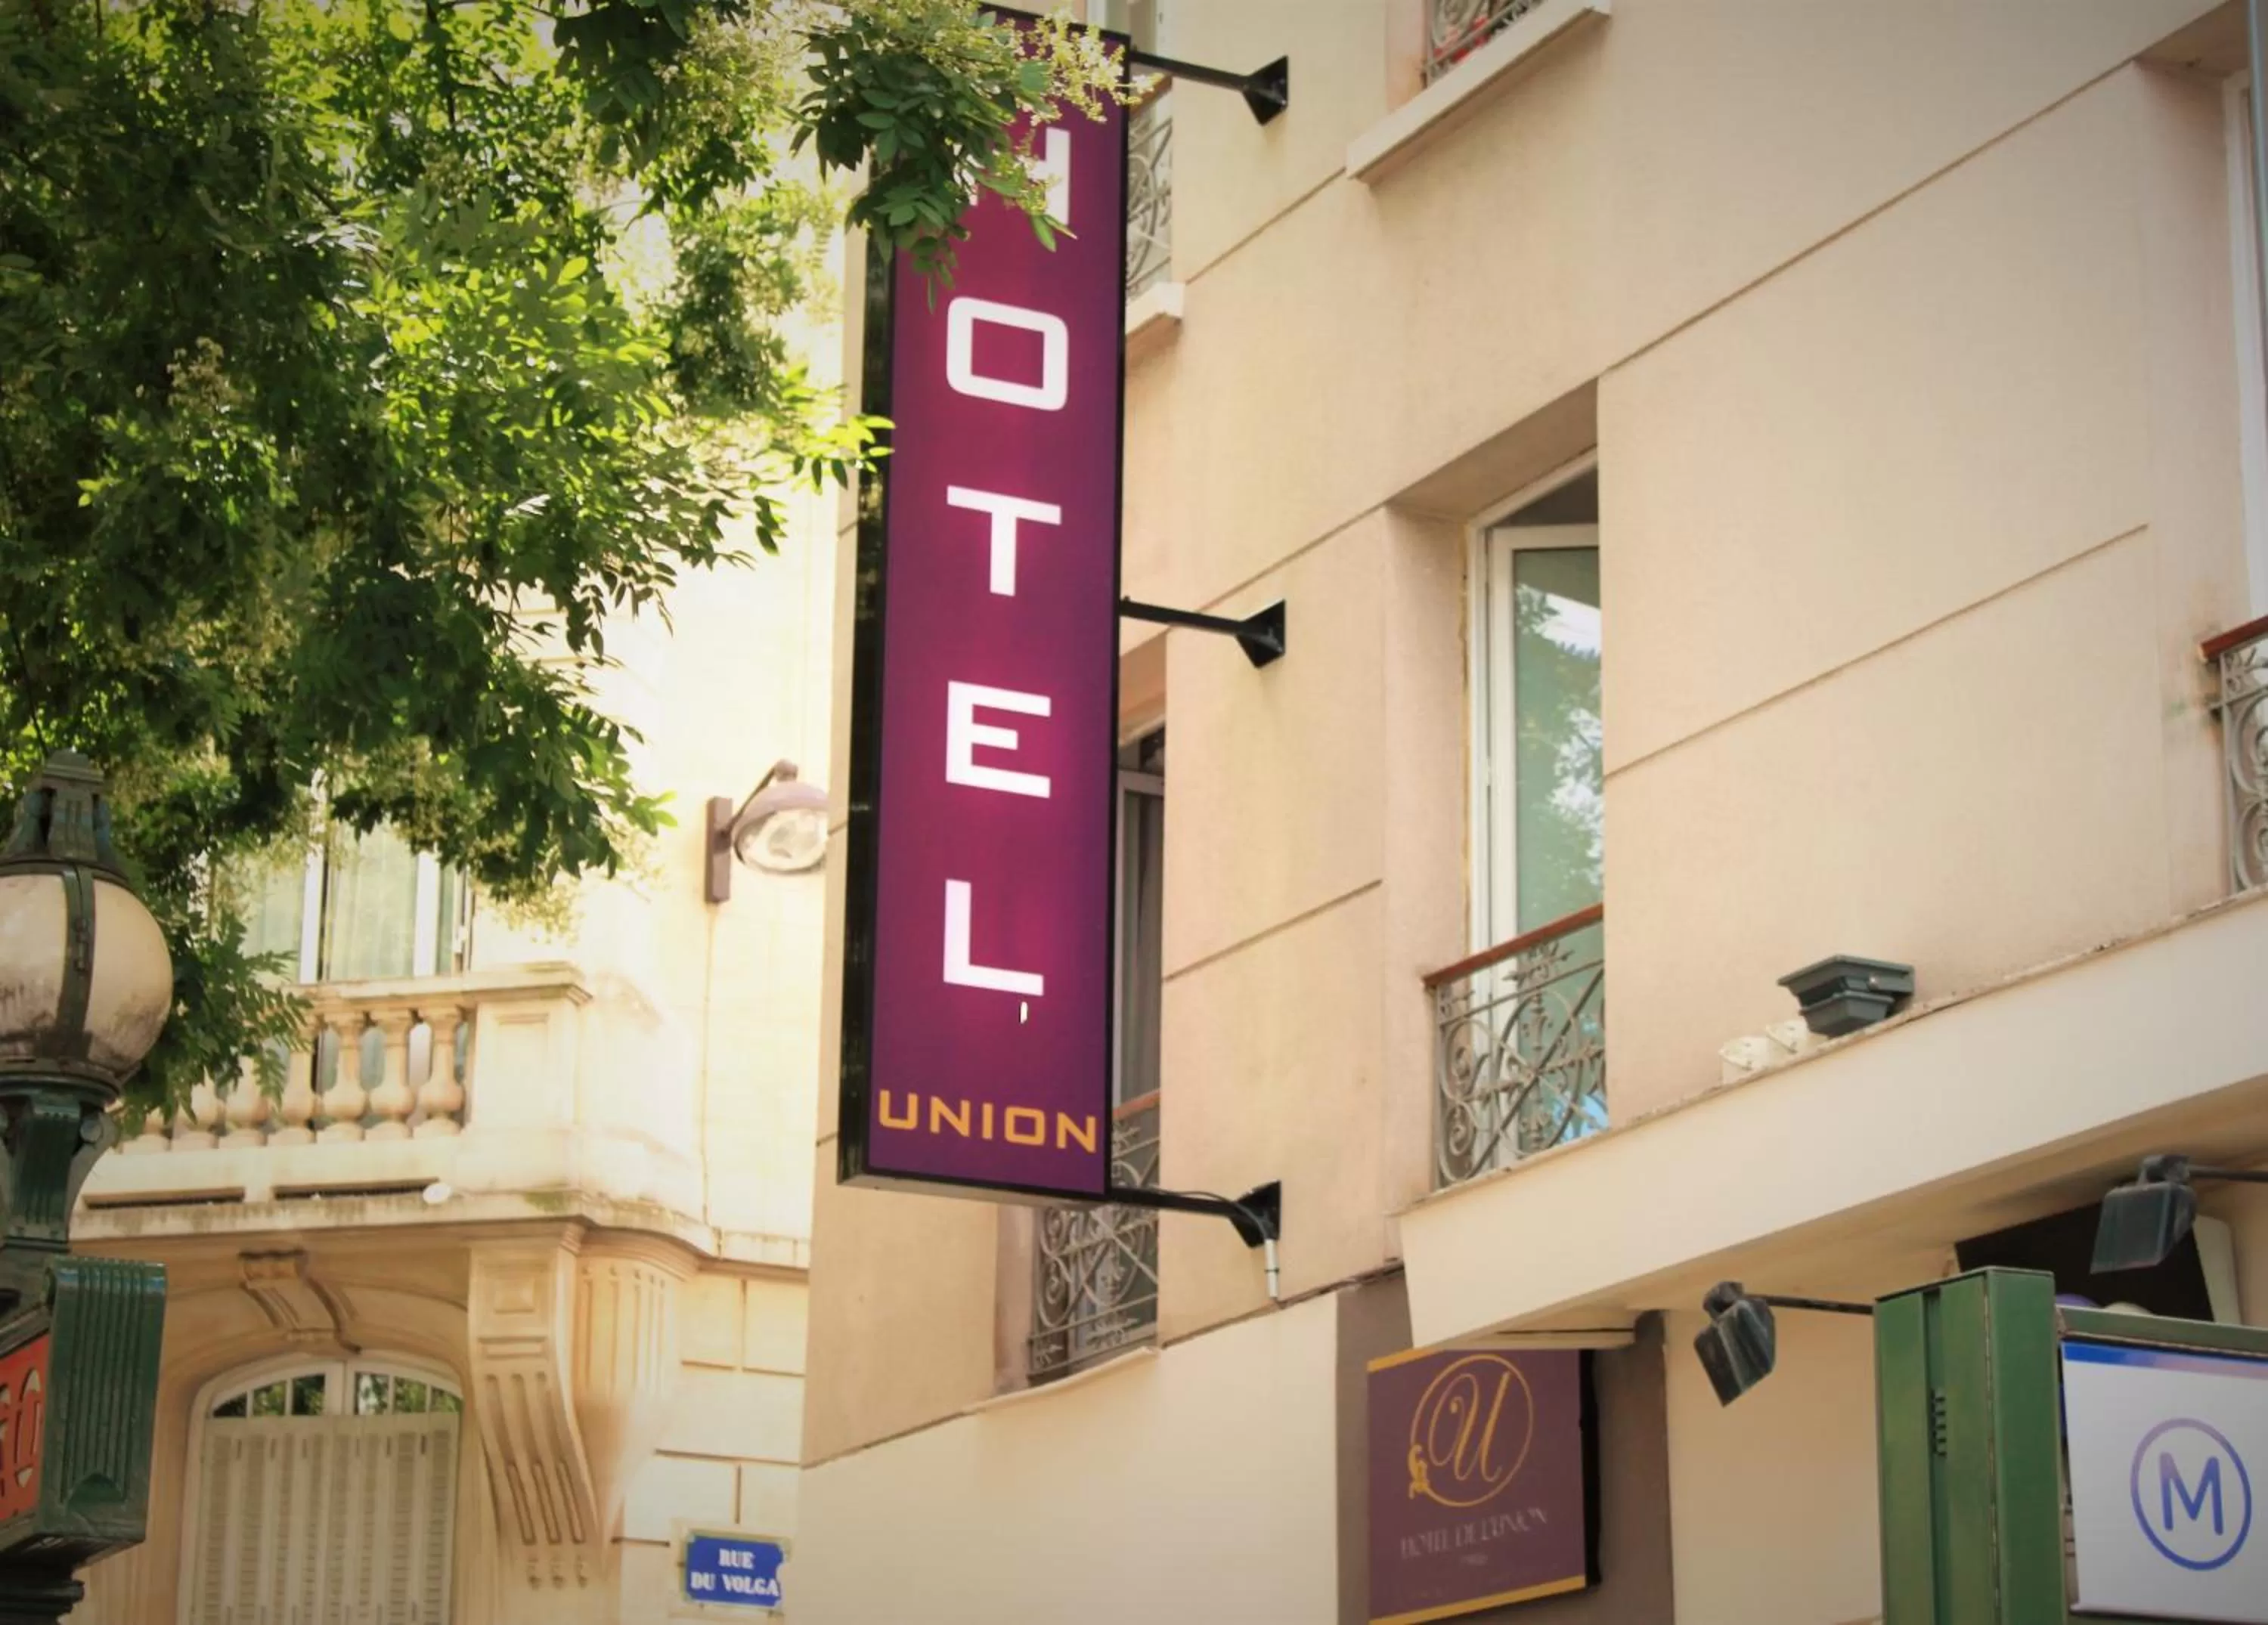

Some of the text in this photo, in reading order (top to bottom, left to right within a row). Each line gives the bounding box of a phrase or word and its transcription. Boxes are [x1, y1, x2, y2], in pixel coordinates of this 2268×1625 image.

[878, 1089, 1096, 1153] UNION
[2158, 1450, 2224, 1537] M
[718, 1547, 754, 1570] RUE
[690, 1571, 780, 1597] DU VOLGA
